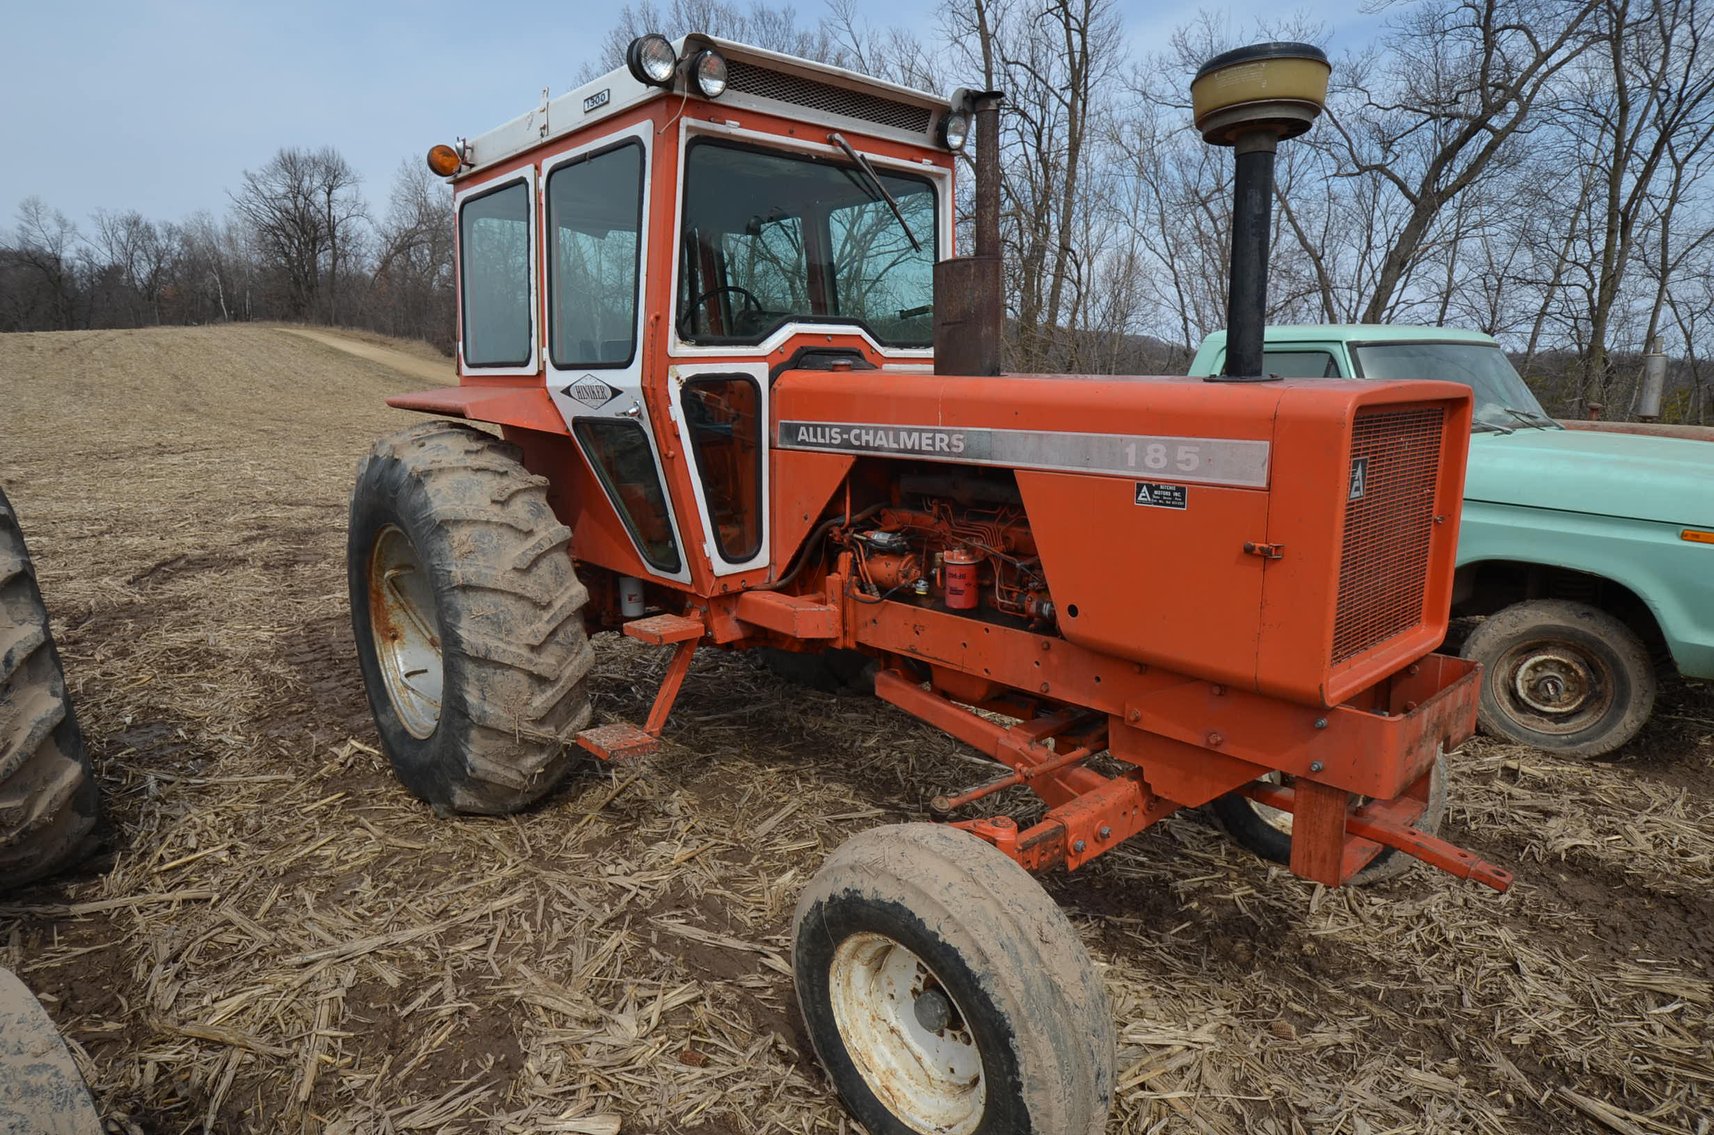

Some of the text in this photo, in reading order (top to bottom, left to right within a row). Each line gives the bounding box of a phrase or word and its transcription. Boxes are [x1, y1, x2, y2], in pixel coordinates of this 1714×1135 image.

[575, 384, 608, 400] HINIKER
[797, 426, 965, 453] ALLIS-CHALMERS
[1125, 443, 1200, 472] 185
